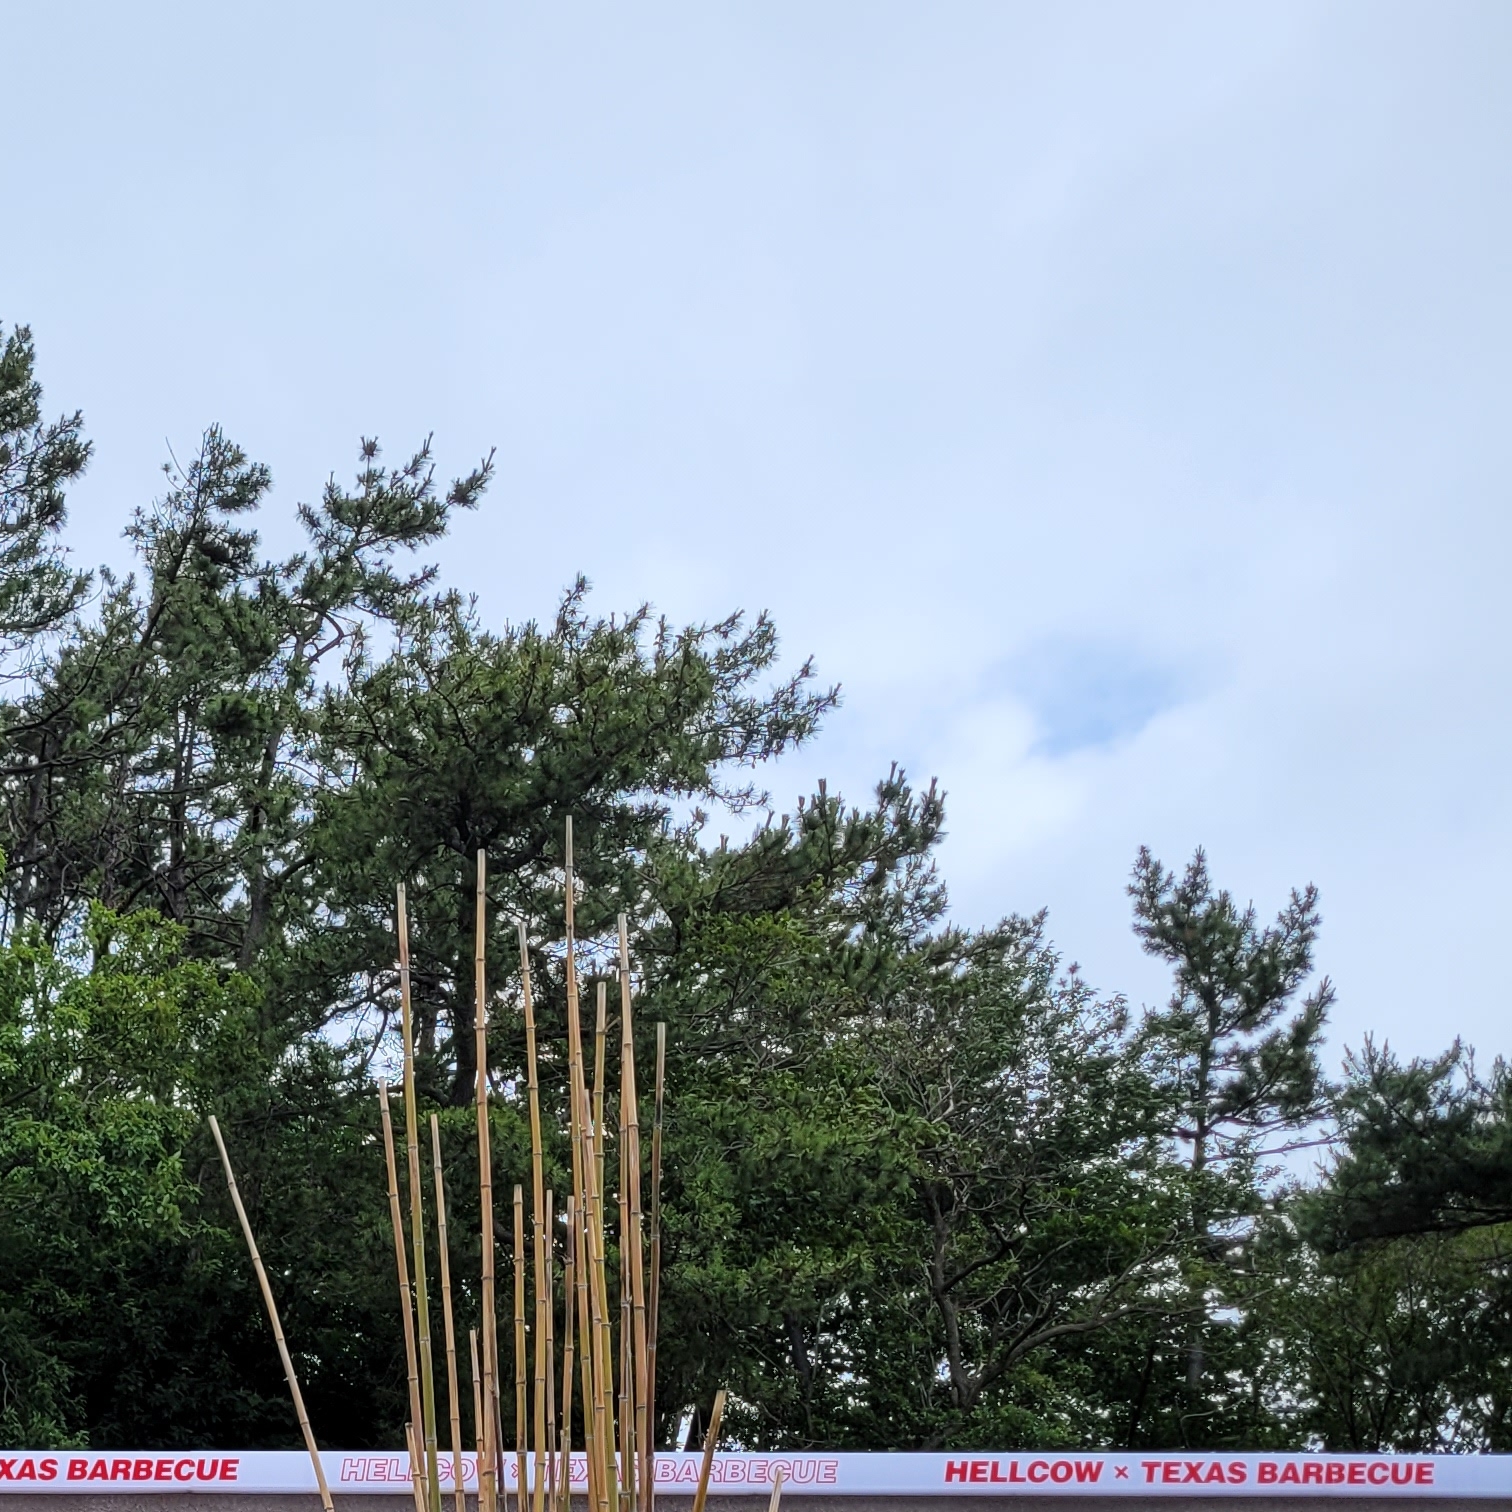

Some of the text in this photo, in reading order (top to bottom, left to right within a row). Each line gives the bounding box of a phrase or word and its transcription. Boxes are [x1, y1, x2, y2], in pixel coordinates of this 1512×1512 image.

[67, 1458, 240, 1482] BARBECUE
[944, 1460, 1105, 1483] HELLCOW
[1141, 1461, 1247, 1484] TEXAS
[1257, 1462, 1434, 1485] BARBECUE
